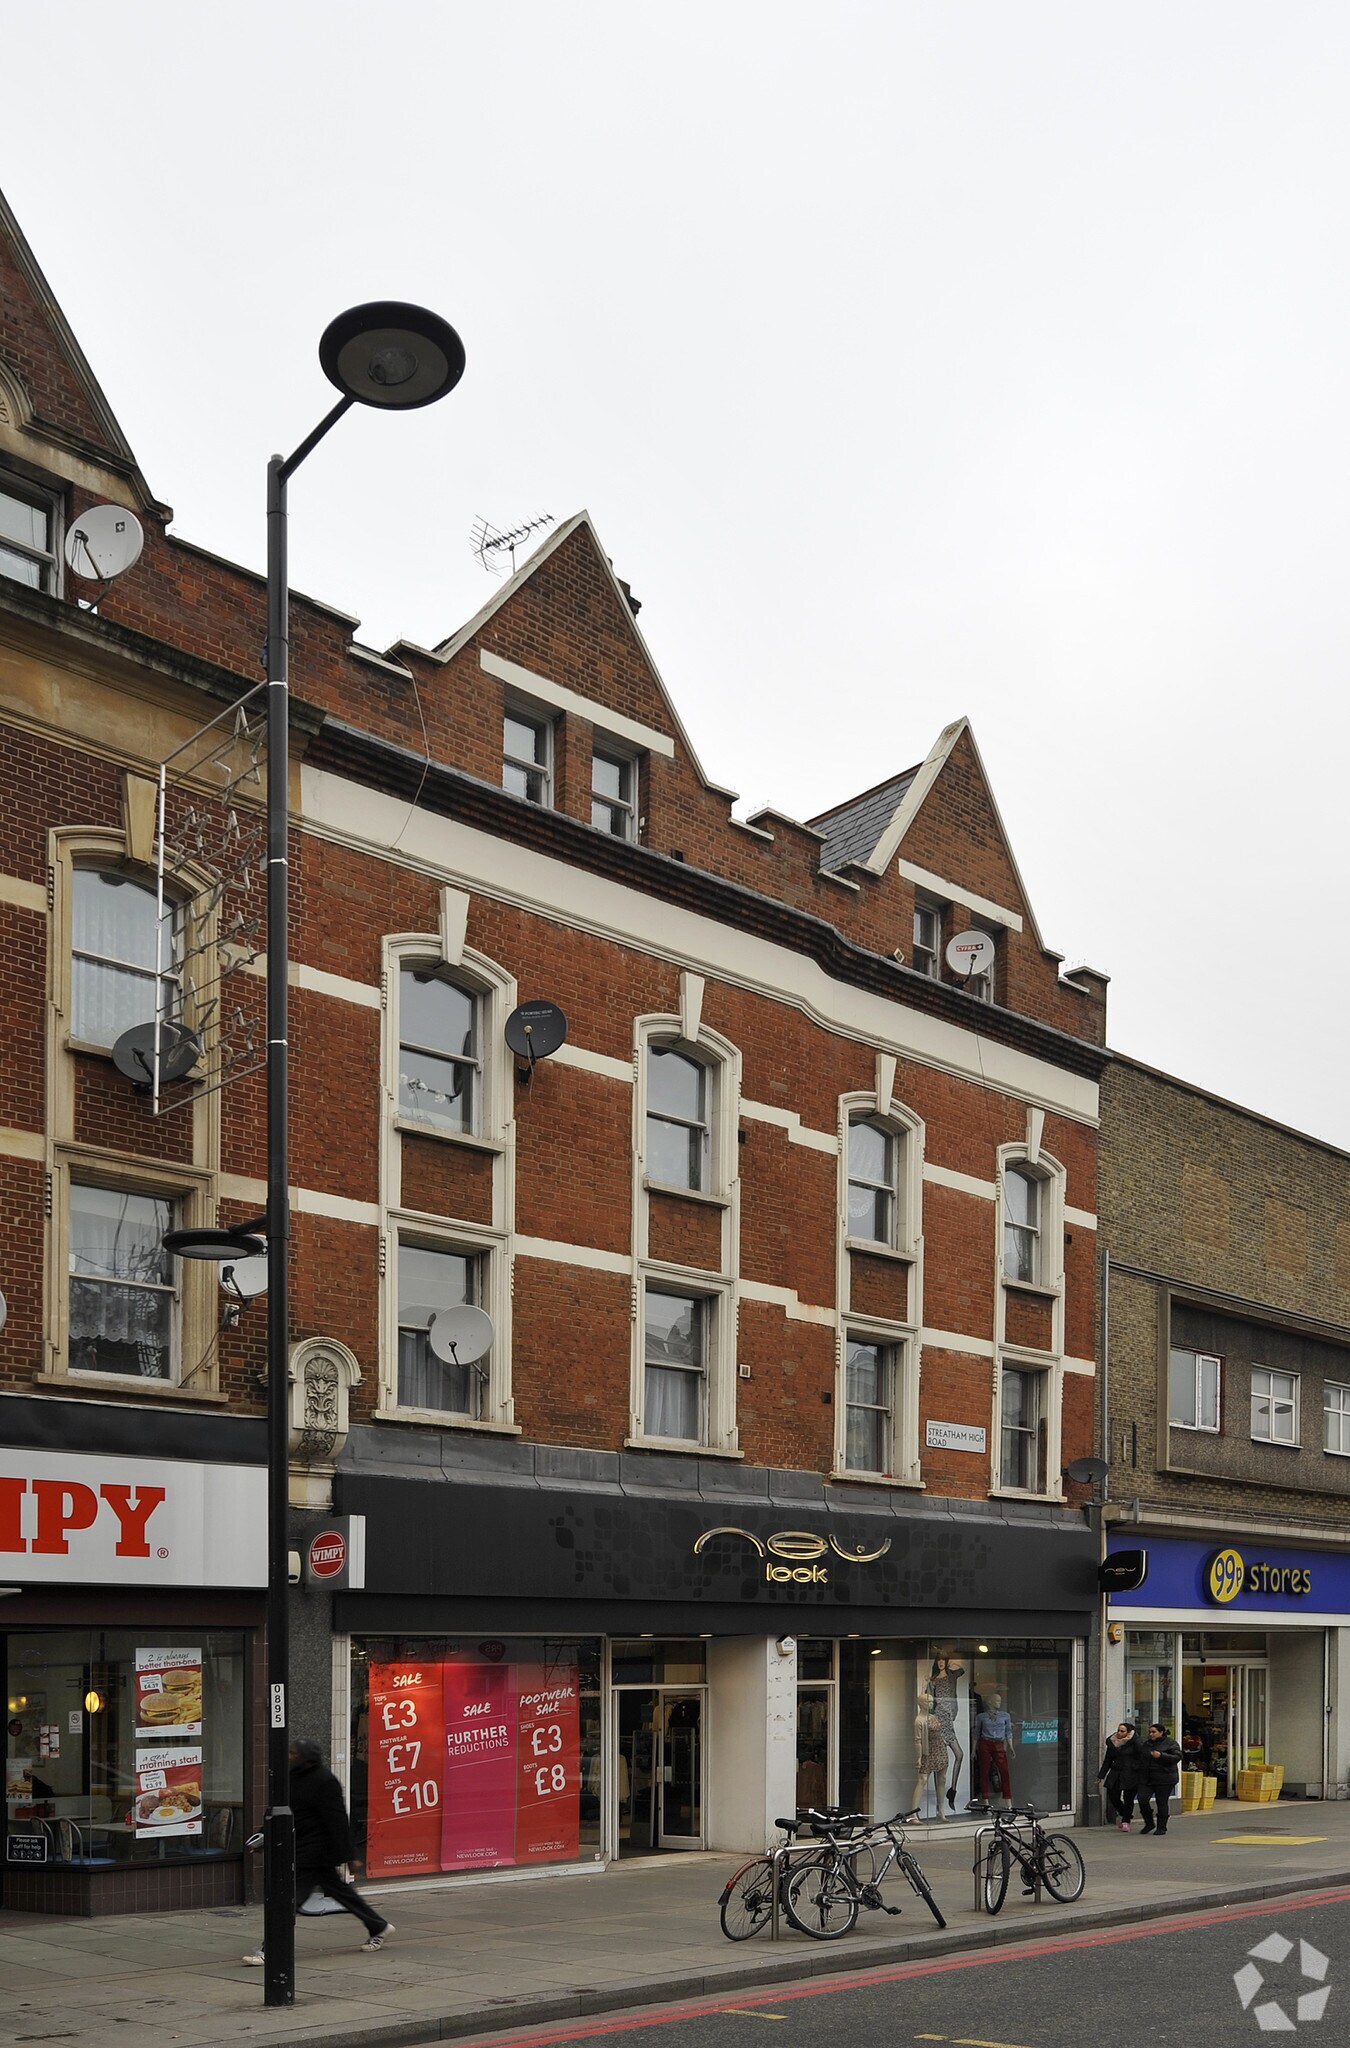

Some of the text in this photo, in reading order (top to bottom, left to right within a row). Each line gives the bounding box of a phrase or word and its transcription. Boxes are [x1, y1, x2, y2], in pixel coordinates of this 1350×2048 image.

[928, 1428, 985, 1443] STREATHAM HIGH
[928, 1437, 947, 1447] ROAD
[312, 1547, 344, 1562] WIMPY
[766, 1563, 828, 1583] look
[1215, 1555, 1311, 1596] 99p stores
[148, 1654, 154, 1662] 2
[393, 1672, 422, 1688] SALE
[520, 1687, 576, 1708] FOOTWEAR
[382, 1700, 417, 1730] £3
[463, 1702, 491, 1717] SALE
[536, 1701, 560, 1716] SALE
[380, 1735, 407, 1745] KNITWEAR
[447, 1725, 508, 1746] FURTHER
[531, 1725, 562, 1756] £3
[1036, 1730, 1058, 1742] £6.99
[448, 1737, 509, 1756] REDUCTIONS
[140, 1755, 198, 1771] morning start
[387, 1741, 422, 1773] £7
[384, 1778, 401, 1787] COATS
[534, 1764, 566, 1796] £8
[392, 1780, 439, 1814] £10
[456, 1850, 498, 1859] NEWLOOK.COM
[528, 1844, 565, 1852] NEWLOOK.COM
[383, 1856, 428, 1865] NEWLOOK.COM
